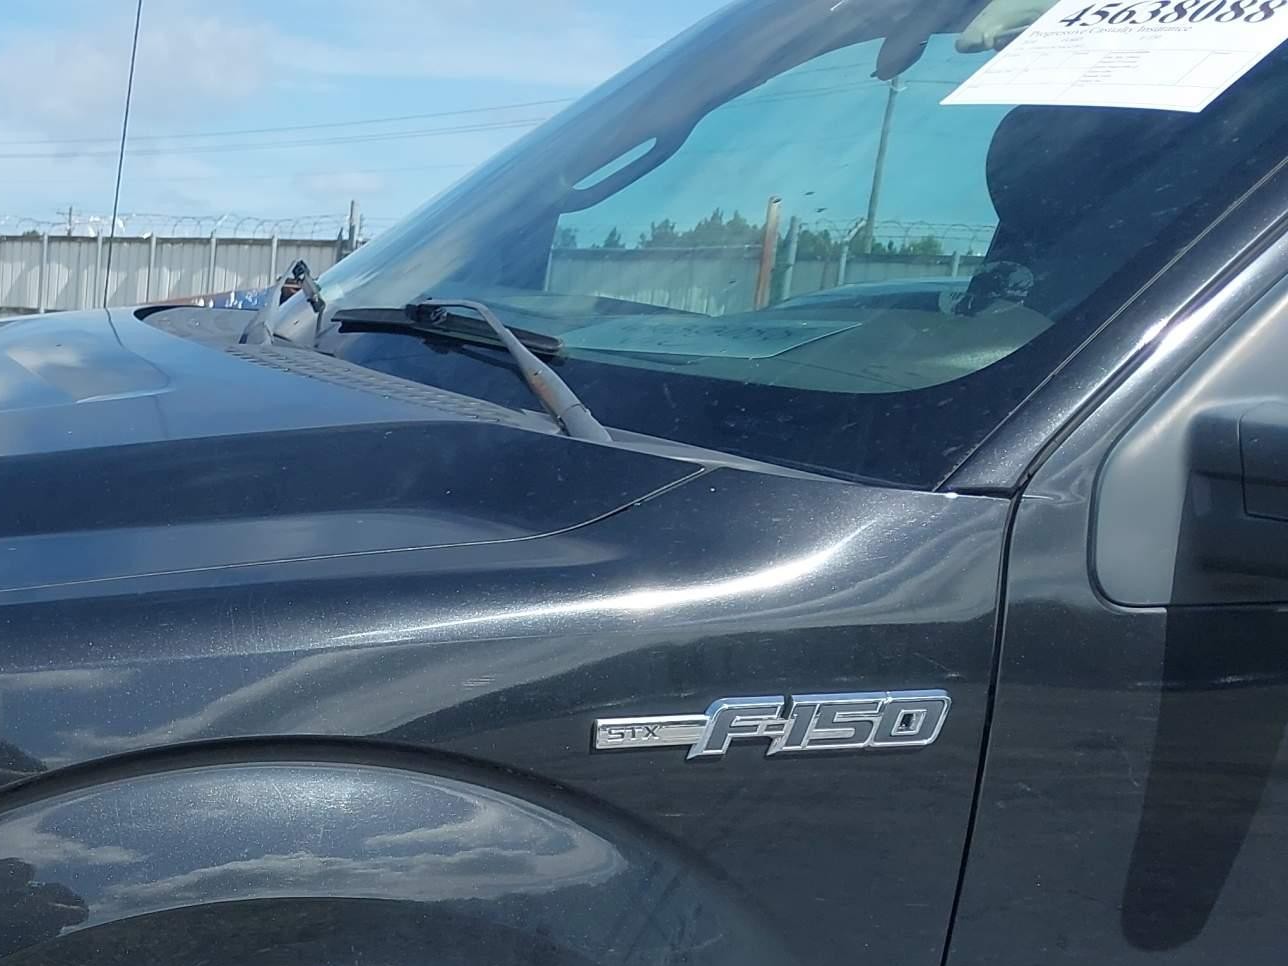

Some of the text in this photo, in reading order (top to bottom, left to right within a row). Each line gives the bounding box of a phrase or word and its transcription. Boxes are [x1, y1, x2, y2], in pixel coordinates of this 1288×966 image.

[1058, 0, 1288, 28] 45638088
[607, 723, 661, 742] STX
[686, 689, 952, 760] F-150
